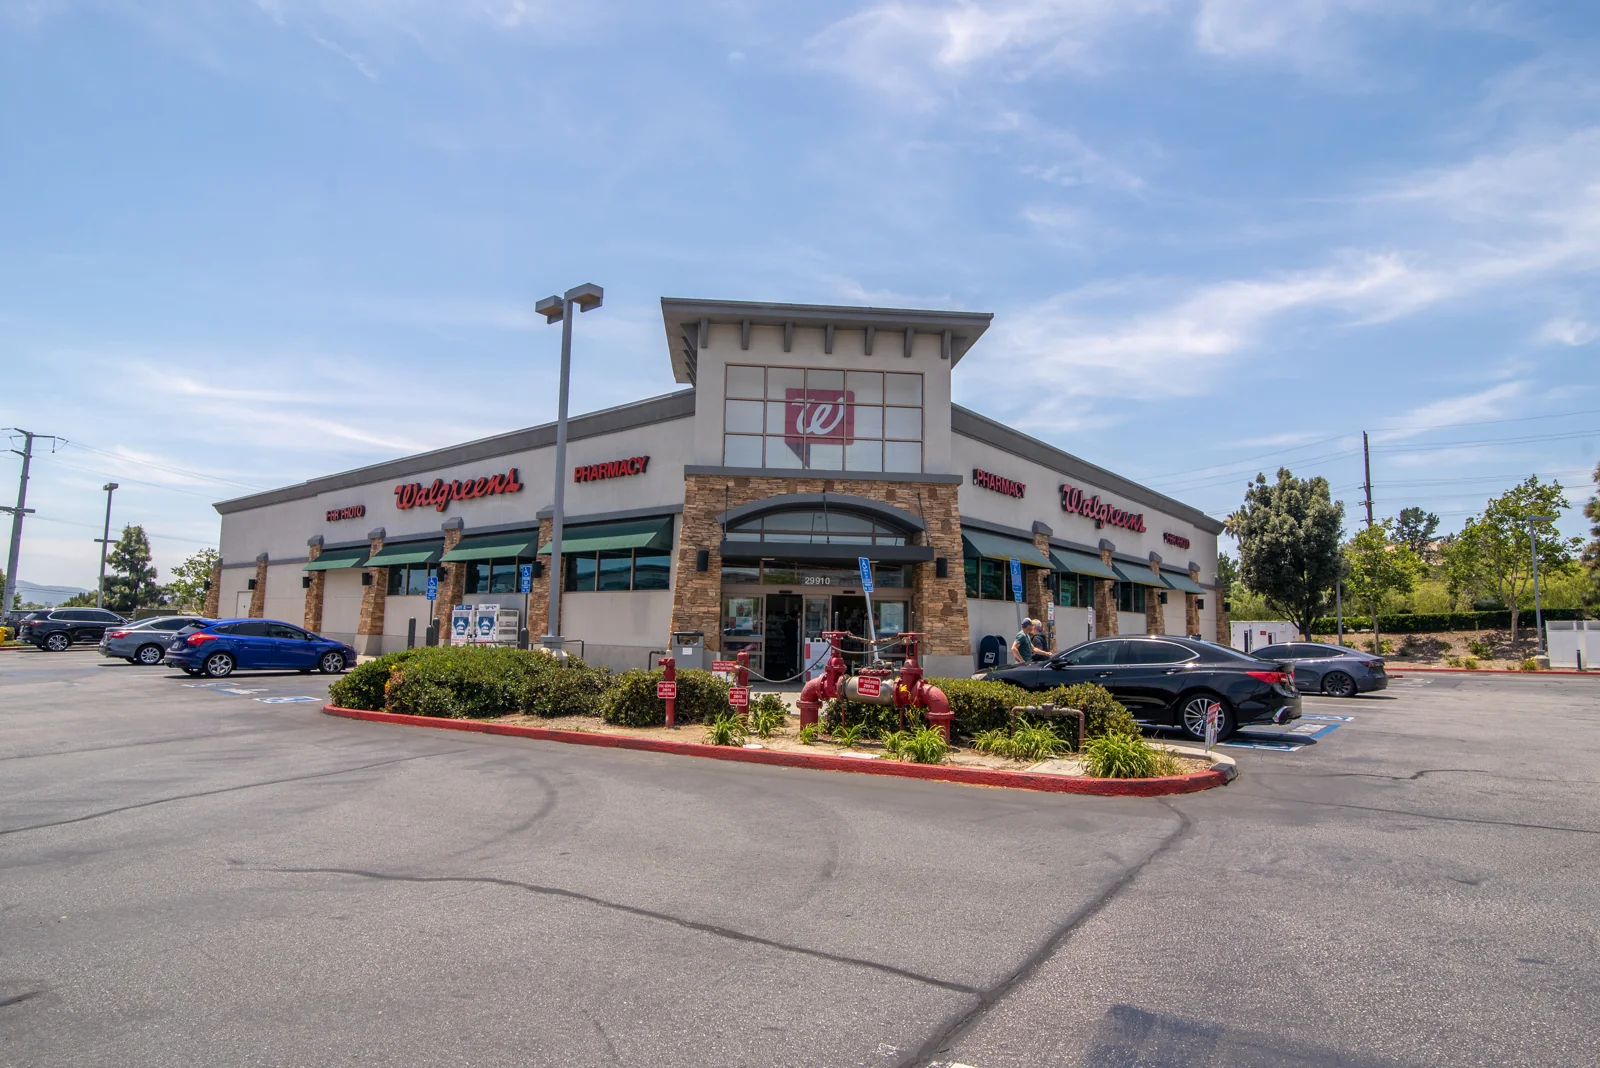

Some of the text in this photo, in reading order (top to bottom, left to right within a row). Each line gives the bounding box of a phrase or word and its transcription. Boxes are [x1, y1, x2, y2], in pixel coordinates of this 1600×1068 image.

[574, 456, 648, 483] PHARMACY
[975, 469, 1026, 498] PHARMACY
[393, 468, 522, 512] Walgreens
[341, 504, 363, 520] PHOTO
[1061, 484, 1147, 533] Walgreens
[804, 576, 831, 585] 29910
